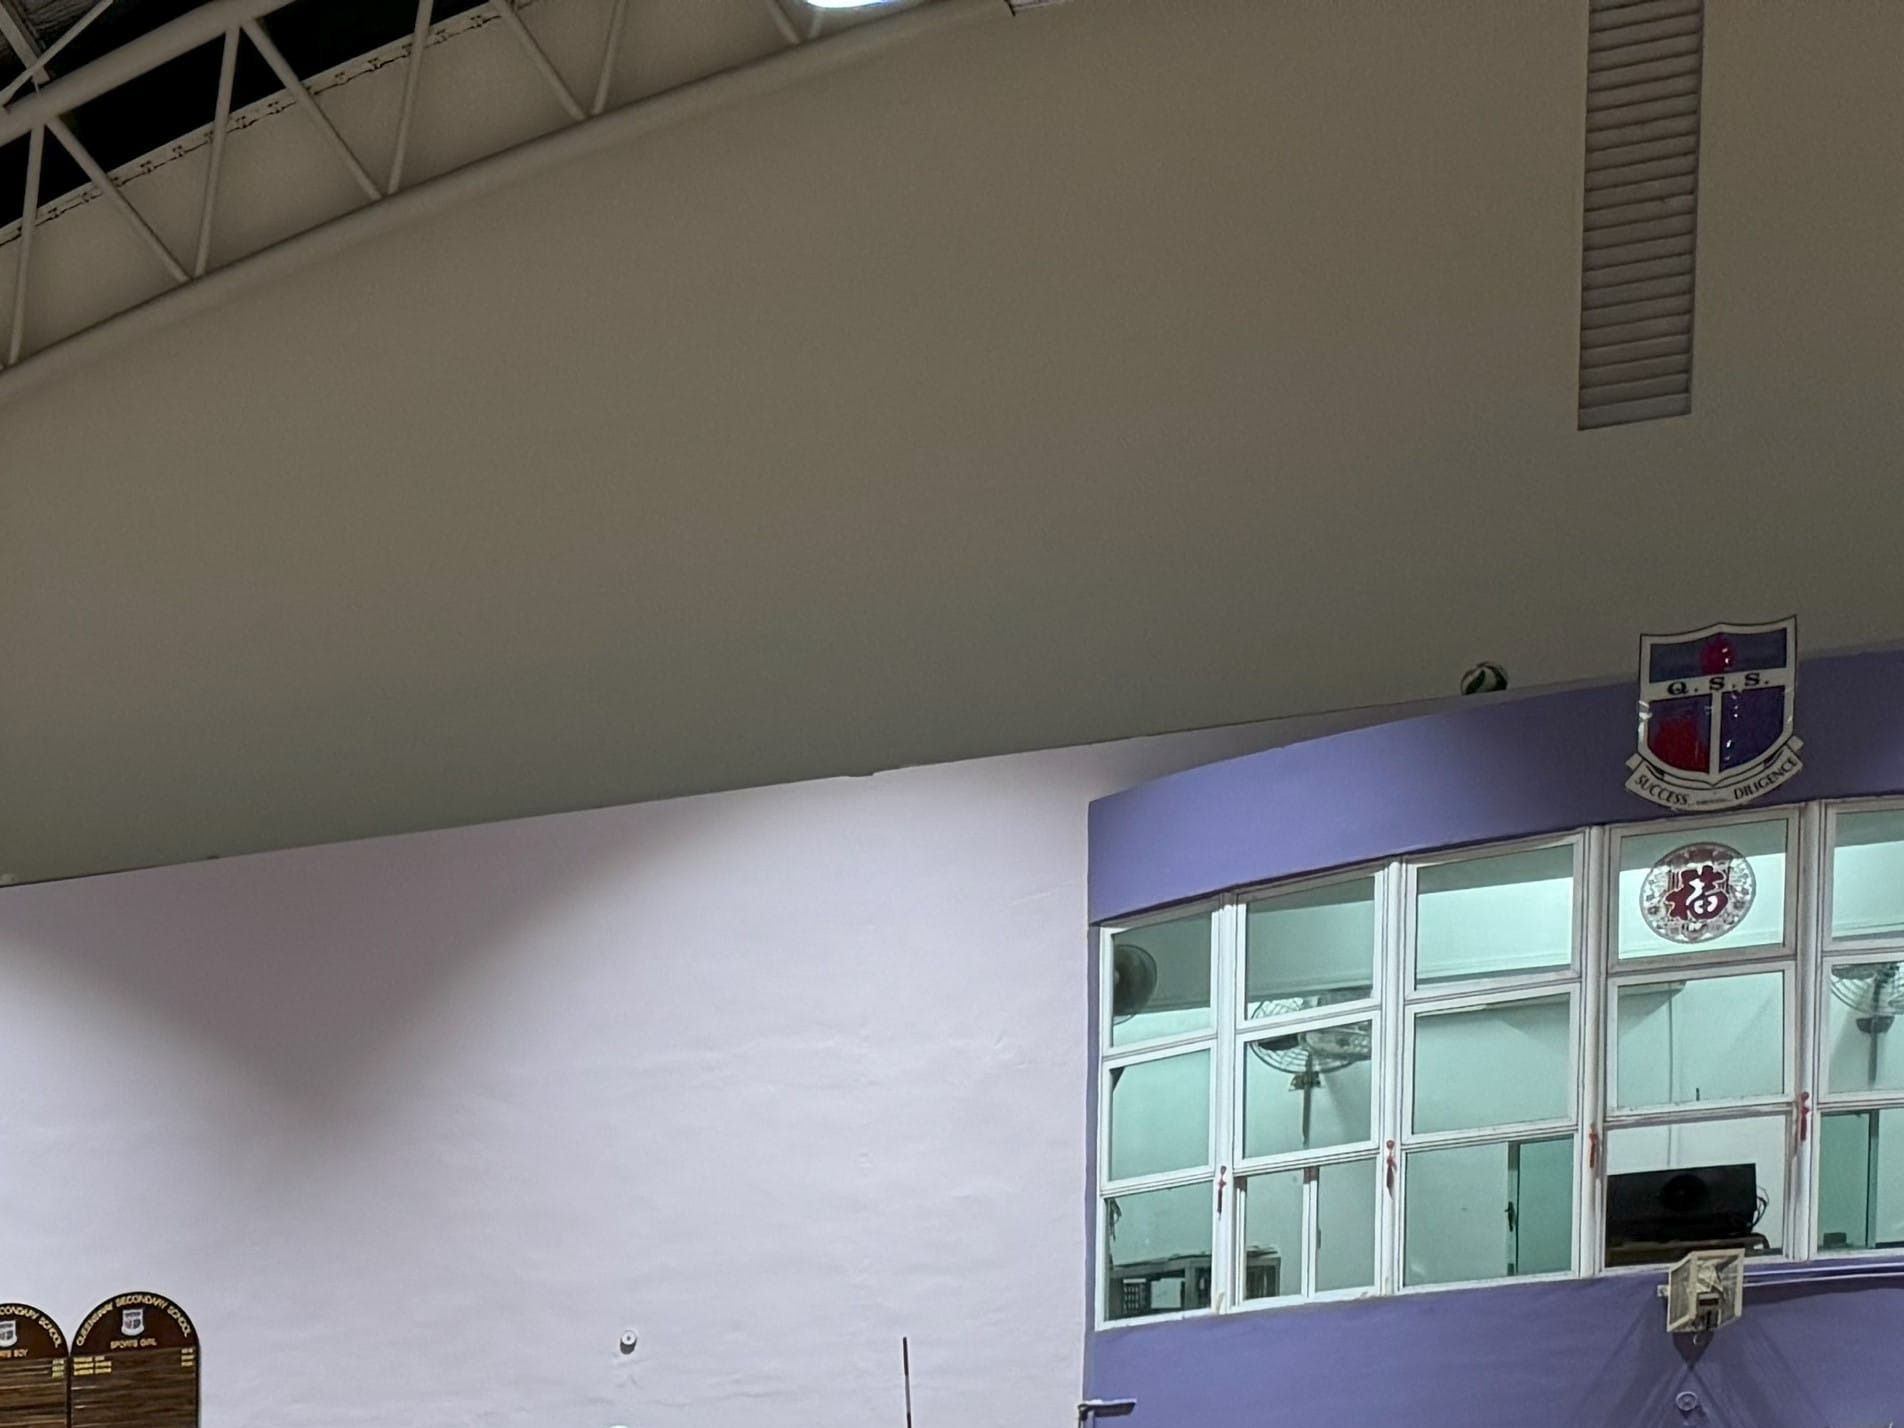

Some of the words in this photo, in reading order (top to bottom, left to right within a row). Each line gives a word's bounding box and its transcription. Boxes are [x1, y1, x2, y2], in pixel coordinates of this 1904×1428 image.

[1667, 672, 1770, 695] Q.S.S.
[1634, 775, 1689, 806] SUCCESS
[1733, 757, 1797, 800] DILIGENCE
[116, 1294, 168, 1309] SECONDARY
